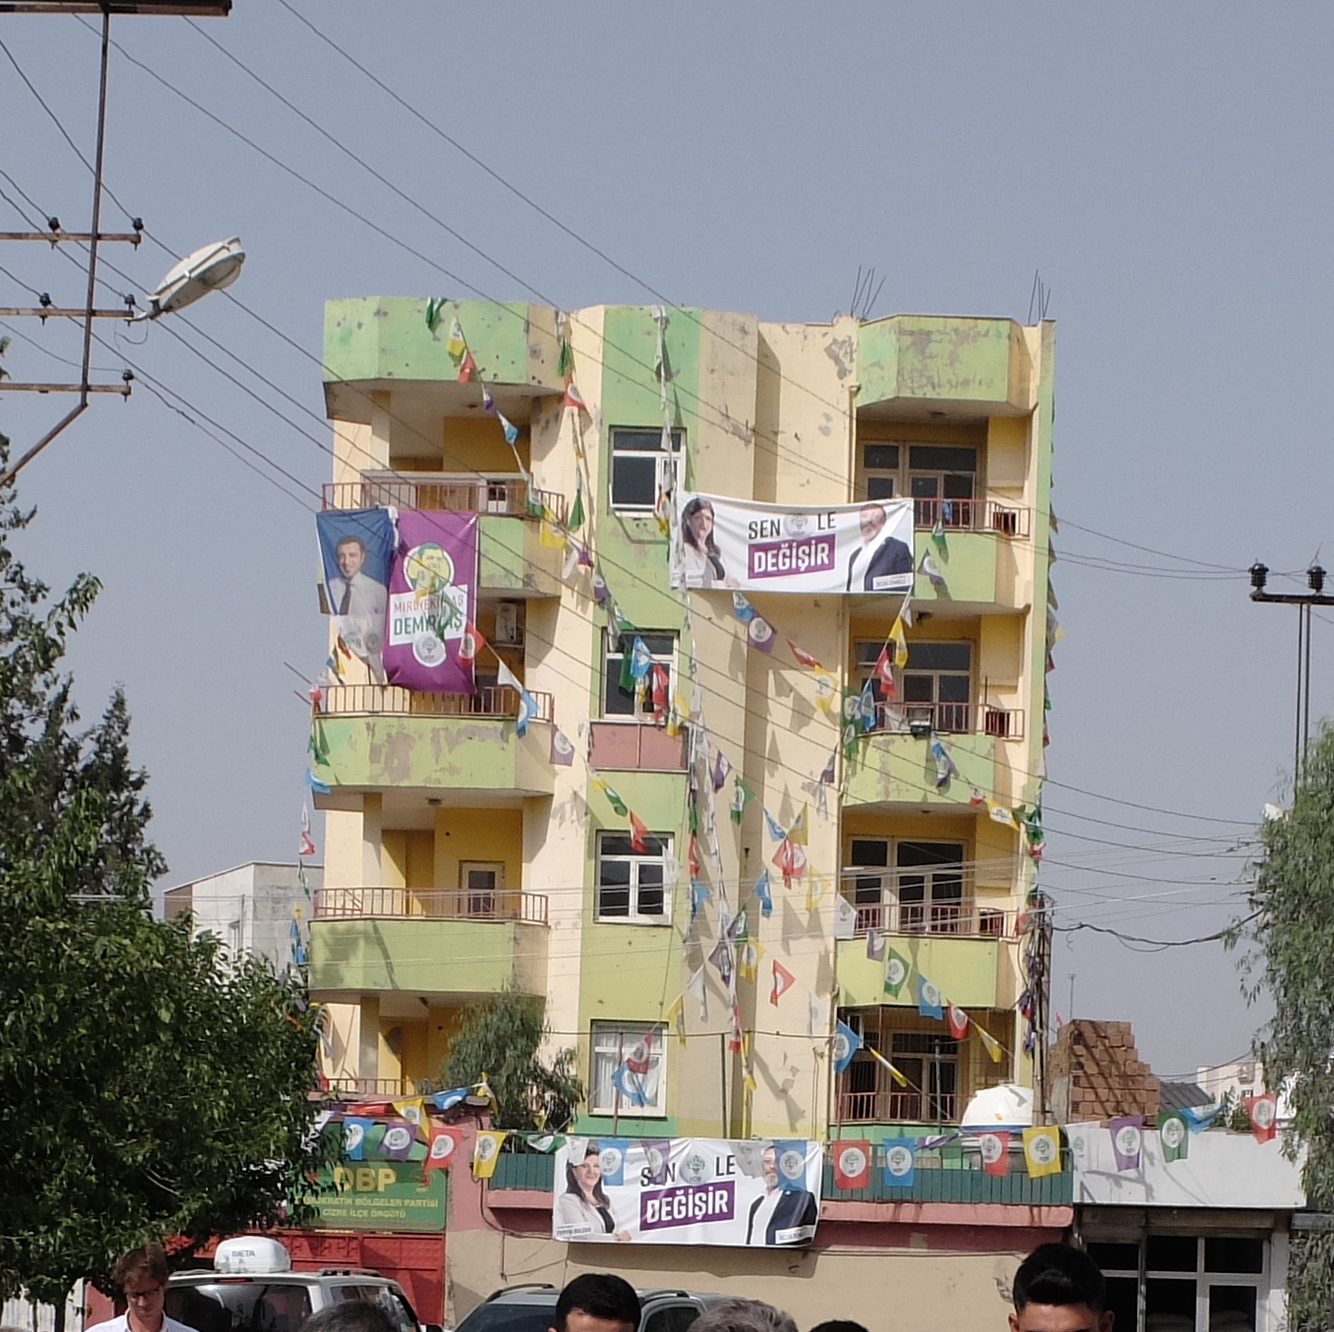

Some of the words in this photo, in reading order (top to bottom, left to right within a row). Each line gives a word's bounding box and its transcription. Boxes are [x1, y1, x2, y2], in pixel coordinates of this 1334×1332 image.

[748, 518, 781, 539] SEN
[818, 511, 837, 531] LE
[753, 539, 830, 574] DEĞİŞİR
[333, 1166, 397, 1193] DBP
[640, 1162, 676, 1188] SN
[716, 1154, 736, 1177] LE
[646, 1186, 729, 1224] DEĞİŞİR
